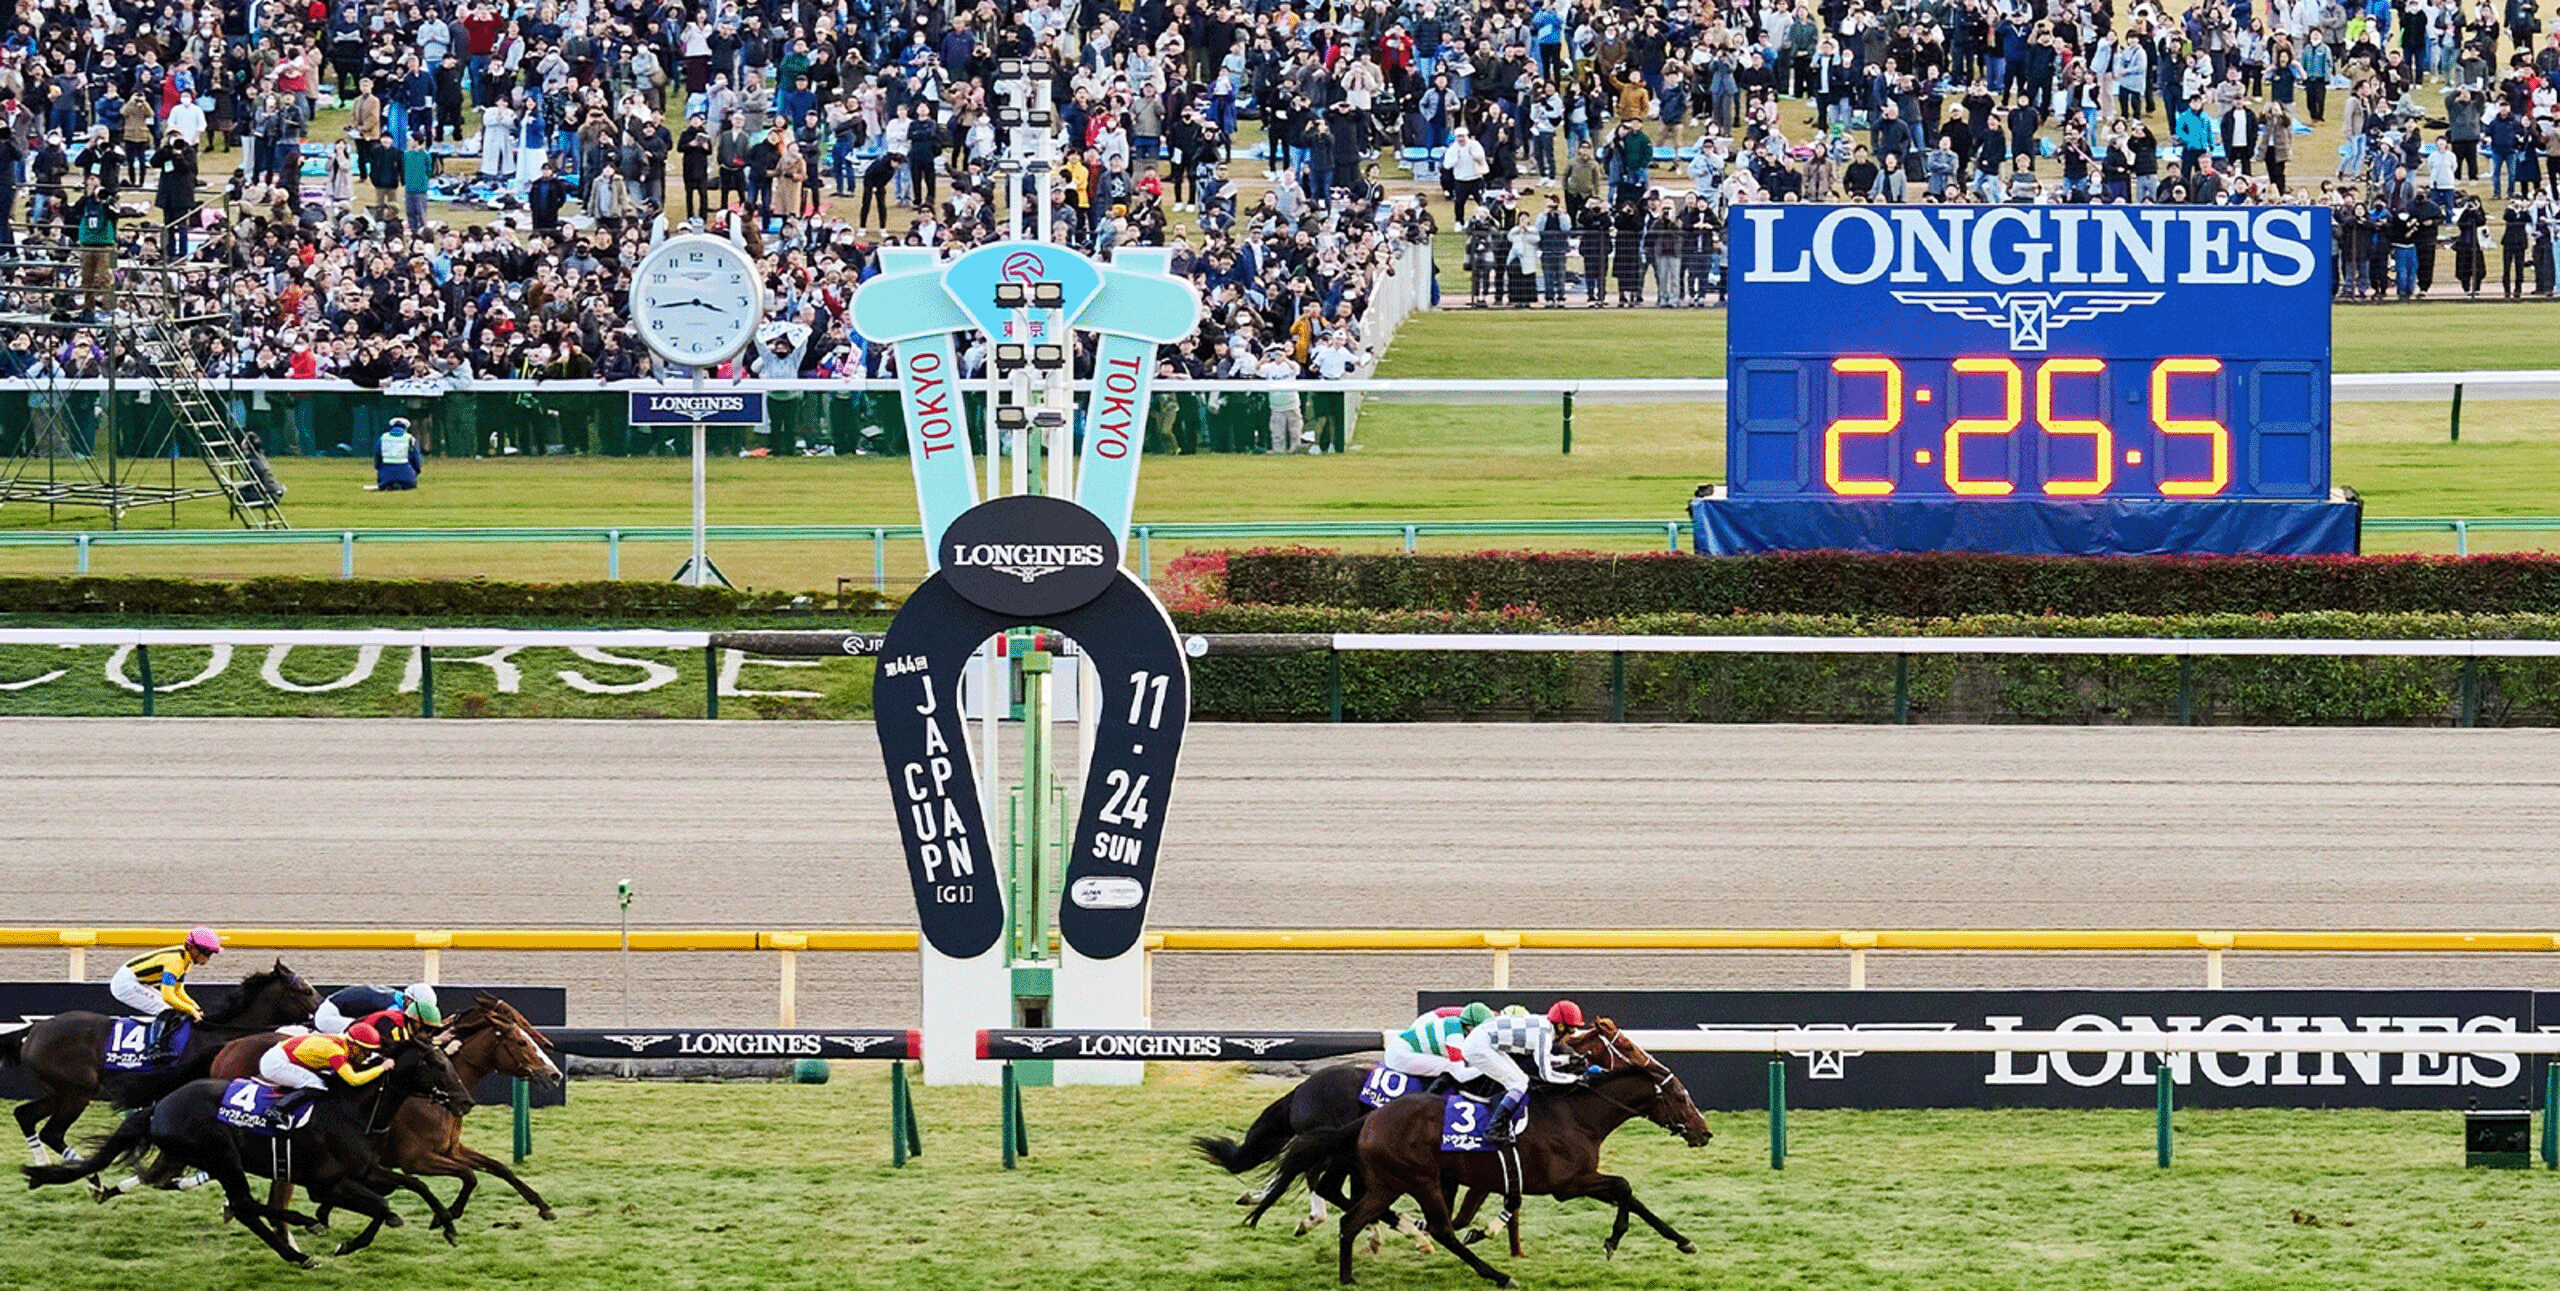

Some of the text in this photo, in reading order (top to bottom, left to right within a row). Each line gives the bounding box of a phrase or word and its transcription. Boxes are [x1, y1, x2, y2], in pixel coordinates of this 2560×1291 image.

[689, 252, 703, 262] 12
[1745, 208, 2316, 286] LONGINES
[717, 258, 723, 268] 1
[652, 273, 667, 284] 10
[730, 273, 741, 284] 2
[736, 296, 748, 308] 3
[652, 319, 664, 330] 8
[728, 319, 740, 330] 4
[691, 341, 703, 353] 6
[650, 397, 744, 411] LONGINES
[910, 353, 953, 459] TOKYO
[1097, 356, 1141, 460] TOKYO
[954, 545, 1104, 566] LONGINES
[916, 674, 975, 878] JAPAN
[903, 762, 943, 883] CUP
[1092, 832, 1142, 866] SUN
[112, 1022, 146, 1052] 14
[678, 1033, 821, 1056] LONGINES
[1079, 1034, 1222, 1057] LONGINES
[1984, 1014, 2521, 1088] LONGINES
[1370, 1068, 1408, 1097] 10
[230, 1084, 259, 1112] 4
[1450, 1101, 1476, 1133] 3
